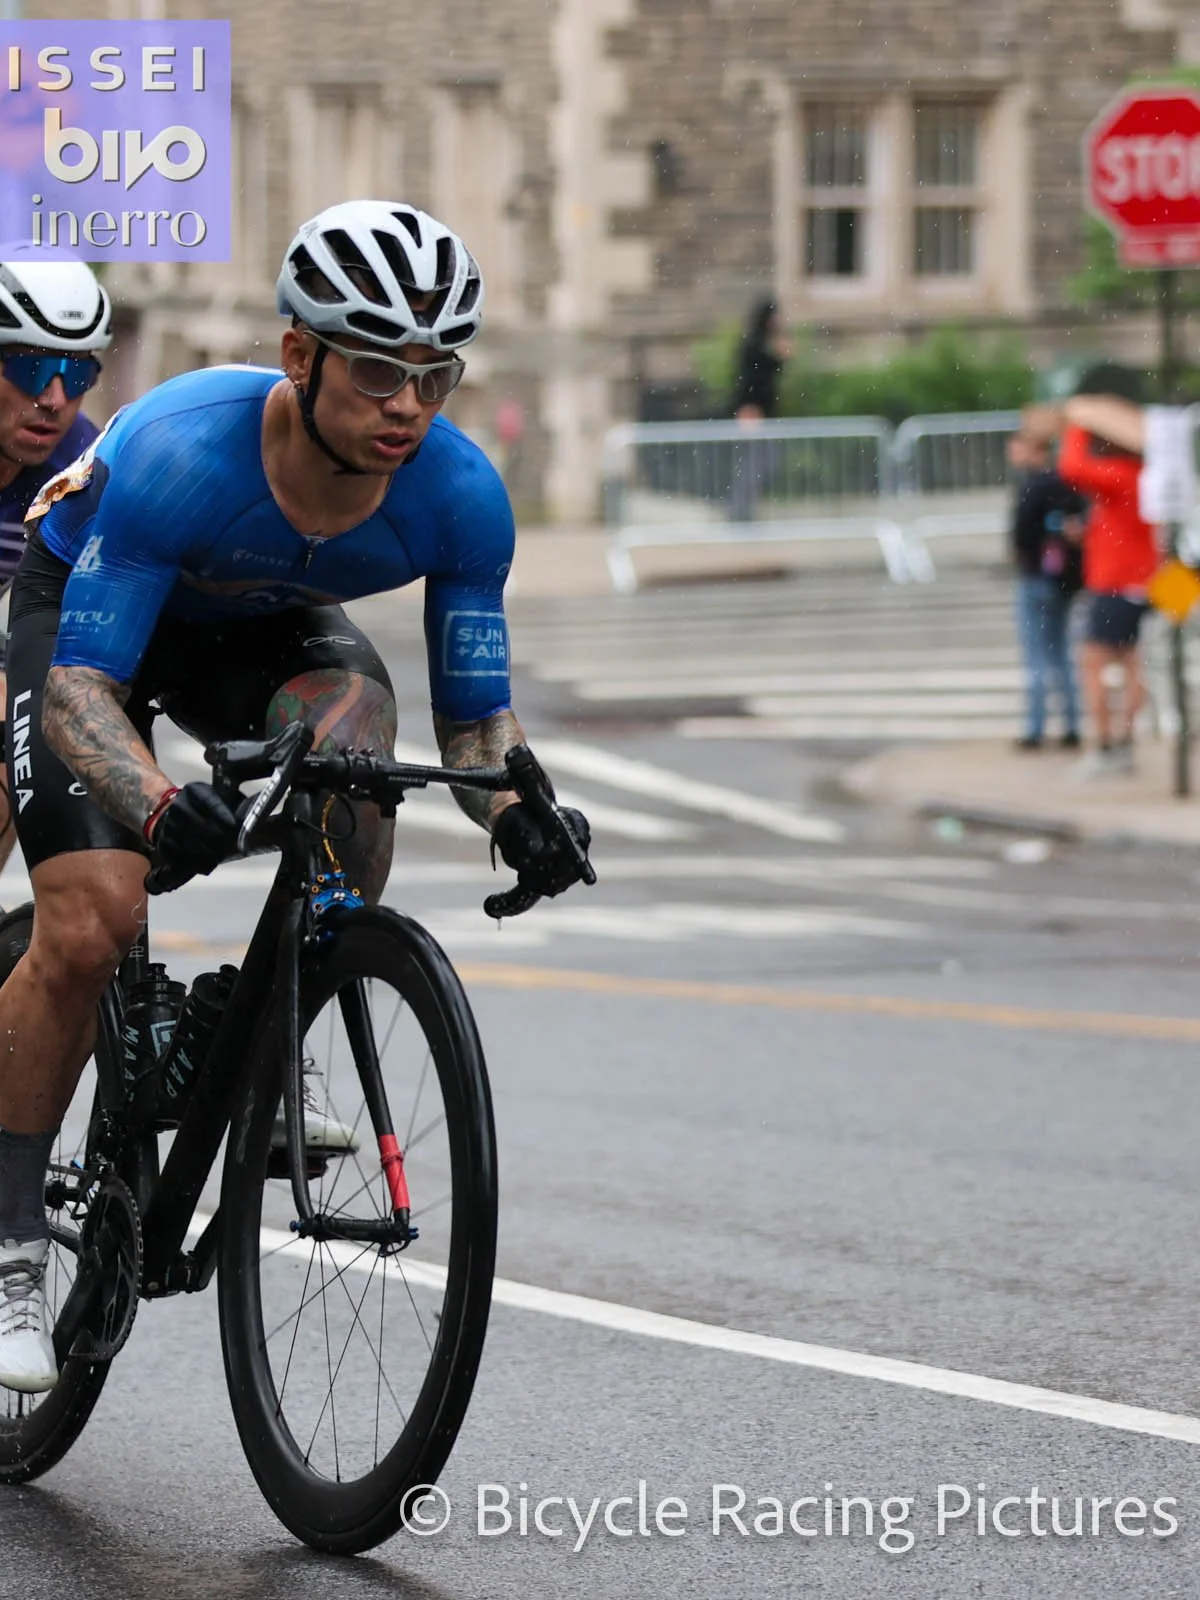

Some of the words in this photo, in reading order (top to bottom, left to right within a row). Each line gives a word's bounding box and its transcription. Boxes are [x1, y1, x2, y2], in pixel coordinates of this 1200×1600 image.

[456, 627, 504, 643] SUN
[456, 644, 507, 659] +AIR
[12, 688, 35, 816] LINEA
